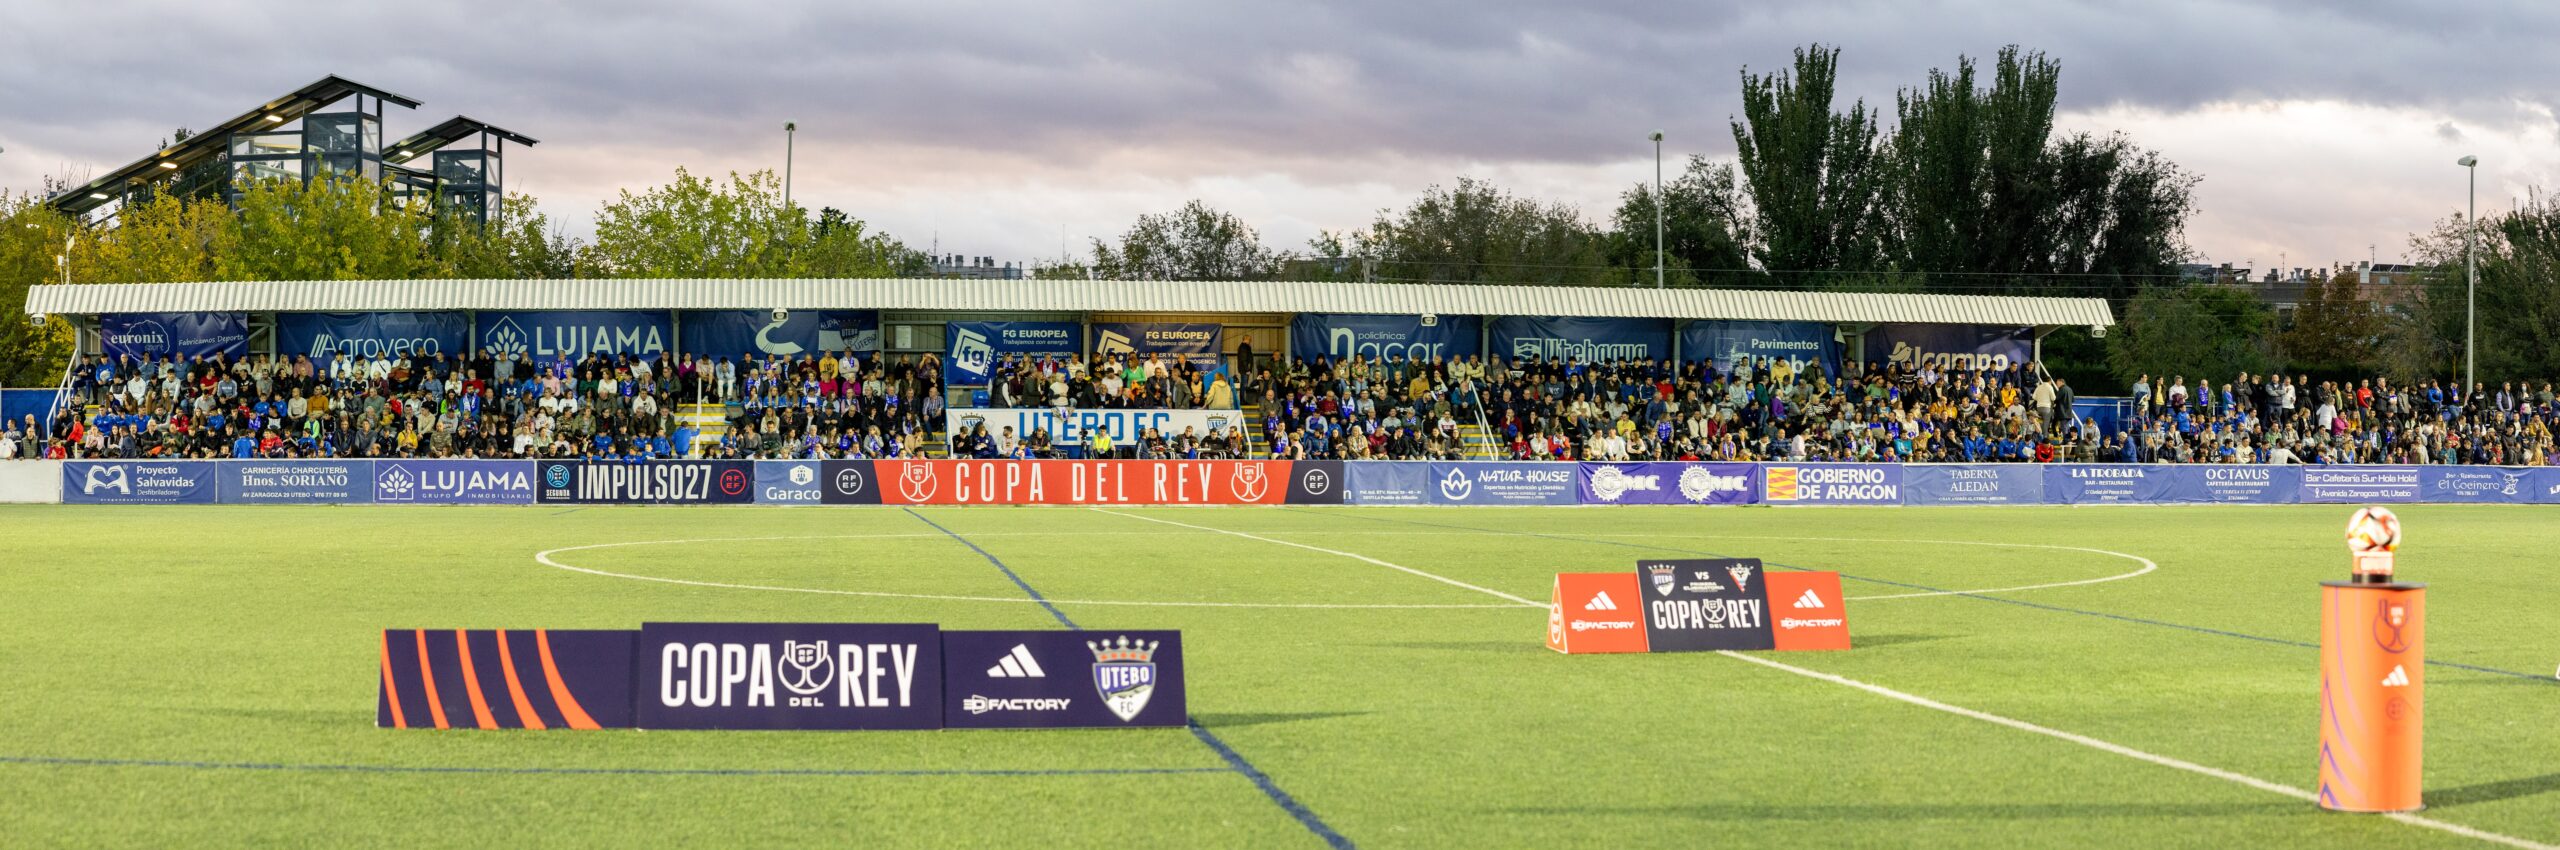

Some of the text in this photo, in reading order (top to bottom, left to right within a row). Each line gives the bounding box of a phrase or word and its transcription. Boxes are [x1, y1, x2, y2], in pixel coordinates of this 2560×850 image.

[110, 331, 164, 344] euronix
[178, 333, 244, 346] Fabricamos Deporte
[1002, 330, 1068, 338] FG EUROPEA
[1146, 331, 1211, 340] FG EUROPEA
[1358, 331, 1406, 341] policlínicas
[309, 334, 439, 363] Agroveco
[536, 325, 664, 365] LUJAMA
[1330, 327, 1444, 364] nacar
[1751, 338, 1819, 350] Pavimentos
[962, 345, 984, 367] fg
[1886, 341, 2009, 371] Alcampo
[1018, 412, 1124, 442] UTEBO
[136, 465, 178, 475] Proyecto
[241, 466, 348, 474] CARNICERÍA CHARCUTERÍA
[1477, 469, 1571, 483] NATUR HOUSE
[1798, 468, 1885, 484] GOBIERNO
[1949, 469, 1998, 479] TABERNA
[2071, 468, 2144, 478] LA TROBADA
[2205, 468, 2270, 480] OCTAVUS
[136, 477, 195, 487] Salvavidas
[242, 475, 348, 486] Hnos. SORIANO
[421, 470, 530, 497] LUJAMA
[578, 464, 712, 500] IMPULSO27
[955, 462, 1212, 502] COPA DEL REY
[2305, 473, 2417, 483] Bar Cafetería Sur Hola Hola!
[1950, 481, 1999, 492] ALEDAN
[2438, 479, 2500, 490] El Cocinero
[1798, 485, 1897, 499] DE ARAGON
[2348, 490, 2379, 498] Zaragoza
[1694, 571, 1710, 580] VS
[1652, 600, 1704, 629] COPA
[1725, 599, 1760, 628] REY
[660, 642, 918, 707] COPA DEL REY
[1100, 665, 1150, 690] UTEBO
[1119, 701, 1134, 713] FC
